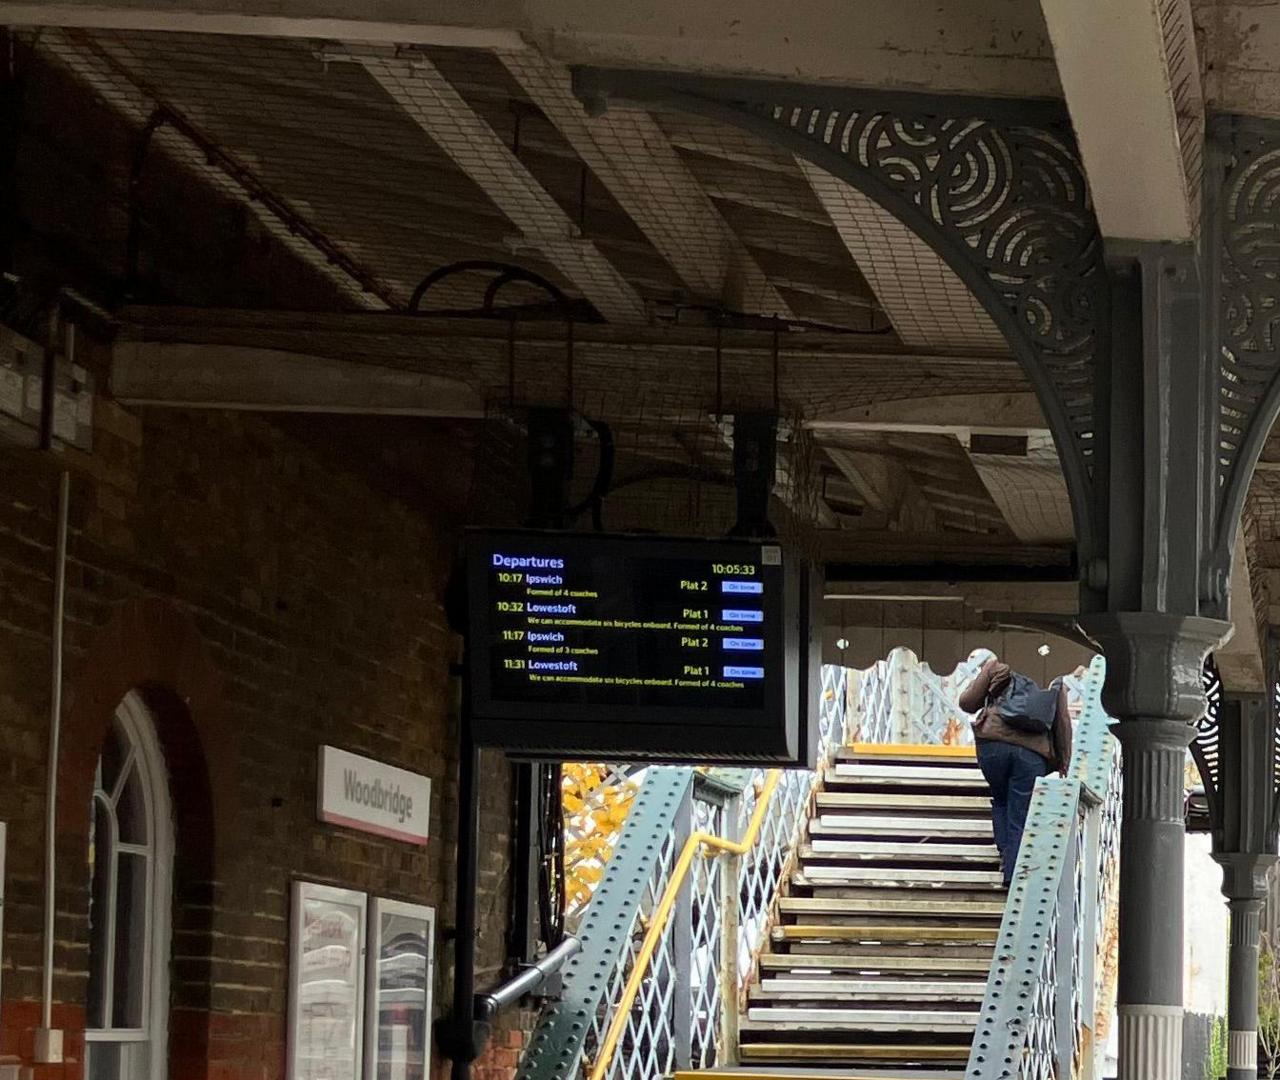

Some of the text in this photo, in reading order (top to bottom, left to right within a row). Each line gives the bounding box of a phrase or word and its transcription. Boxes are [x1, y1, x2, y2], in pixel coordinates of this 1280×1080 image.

[492, 554, 564, 569] Departures
[711, 564, 755, 575] 10:05:33
[498, 572, 523, 583] 10:17
[526, 573, 563, 585] Ipswich
[680, 581, 699, 590] Plat
[701, 581, 708, 591] 2
[497, 602, 524, 612] 10:32
[527, 601, 577, 614] Lowestoft
[683, 608, 701, 619] Plat
[703, 609, 709, 619] 1
[503, 630, 525, 641] 11:17
[527, 631, 565, 642] Ipswich
[681, 637, 700, 648] Plat
[702, 637, 709, 648] 2
[504, 659, 525, 669] 11:31
[528, 659, 578, 671] Lowestoft
[683, 665, 702, 675] Plat
[704, 666, 710, 675] 1
[344, 767, 413, 824] Woodbridge
